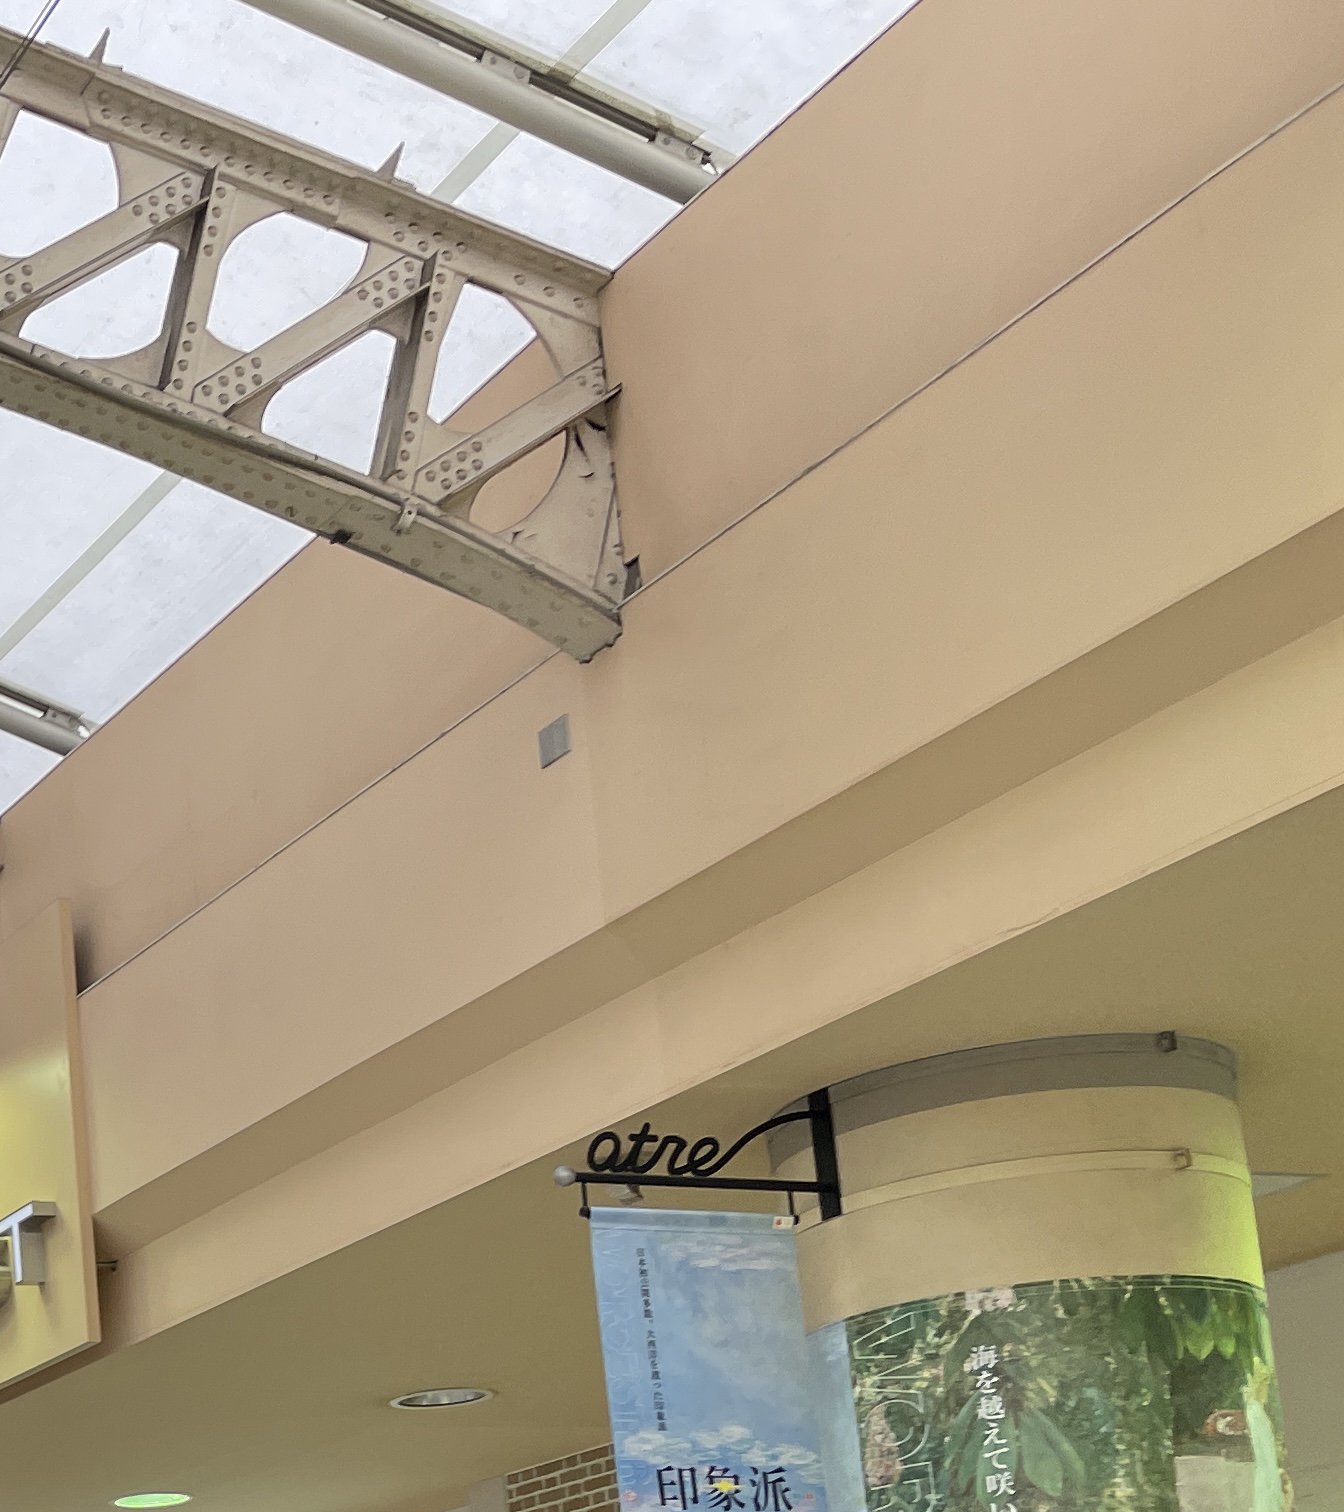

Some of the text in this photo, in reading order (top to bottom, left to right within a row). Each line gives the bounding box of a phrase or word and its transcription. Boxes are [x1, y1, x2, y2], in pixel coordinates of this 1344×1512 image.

[587, 1122, 722, 1176] atre
[656, 1465, 794, 1512] 印象派
